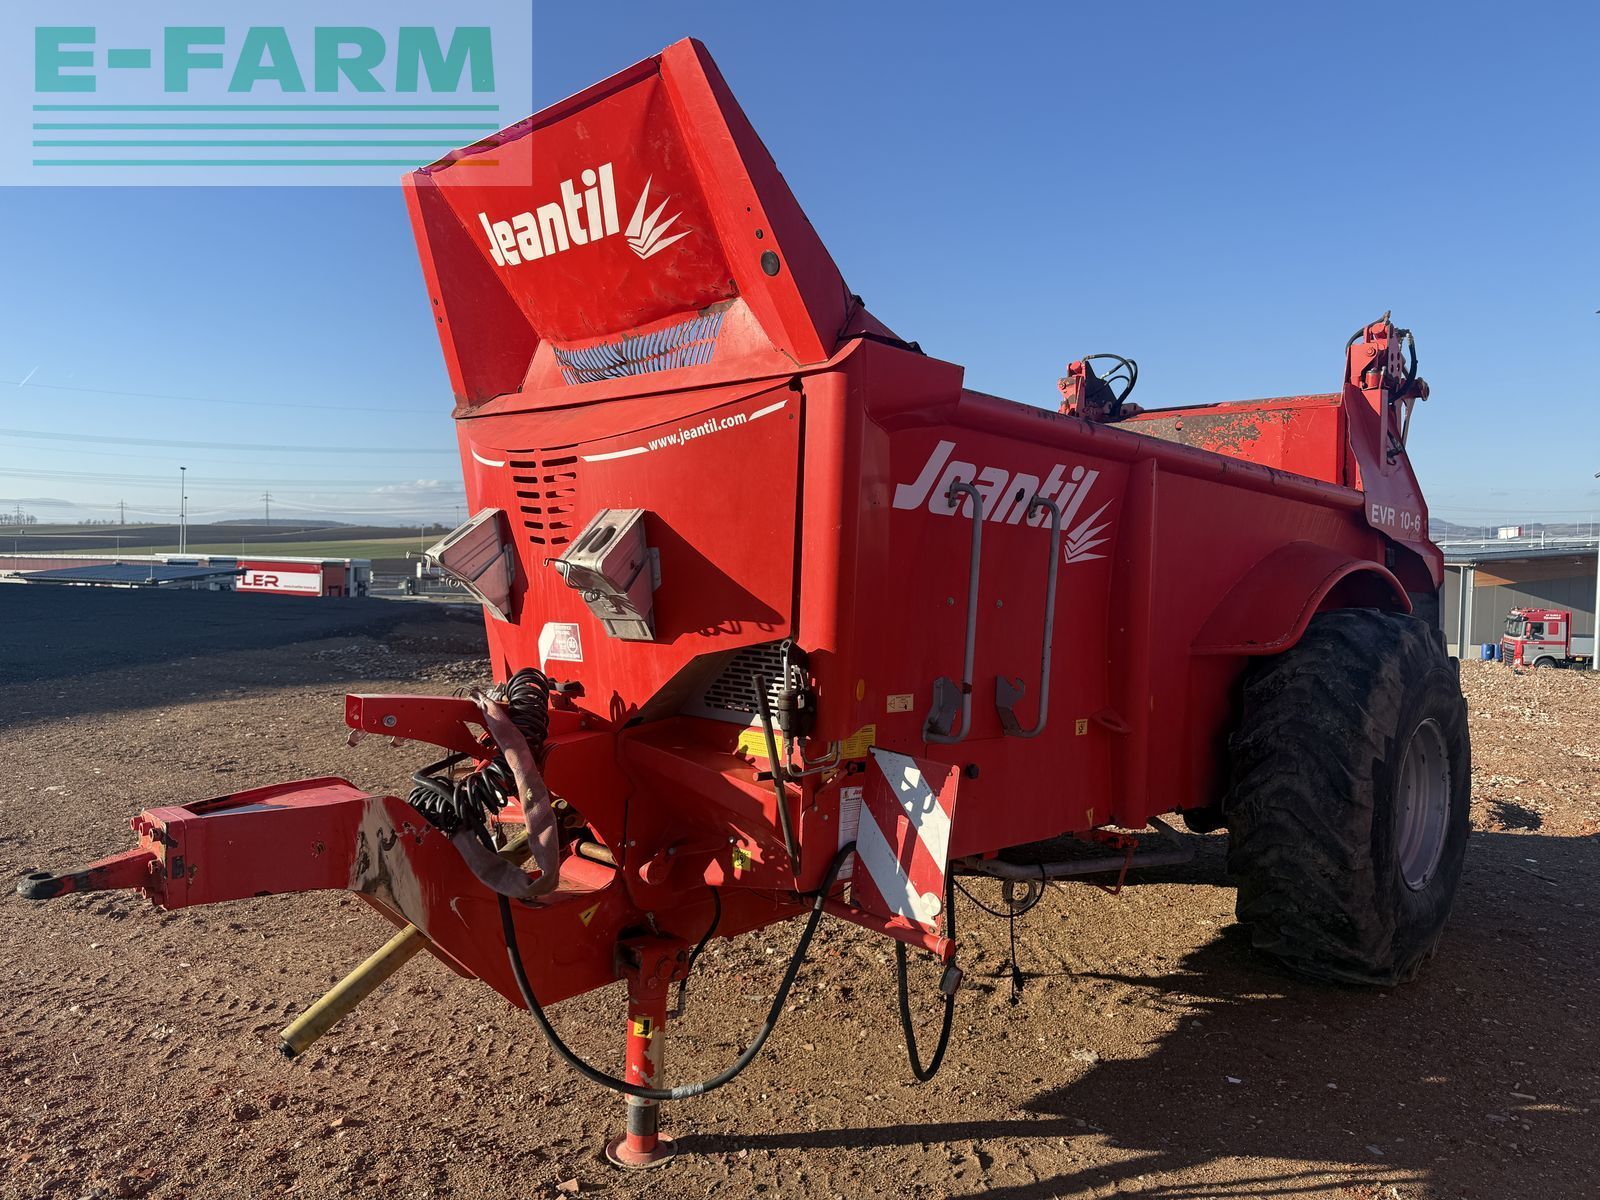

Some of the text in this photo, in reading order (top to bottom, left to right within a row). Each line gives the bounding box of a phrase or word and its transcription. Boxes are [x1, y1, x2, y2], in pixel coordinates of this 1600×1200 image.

[478, 162, 620, 267] Jeantil
[648, 412, 748, 451] www.jeantil.com
[892, 439, 1100, 531] Jeantil
[1371, 503, 1421, 532] EVR 10-6
[236, 574, 279, 587] LER
